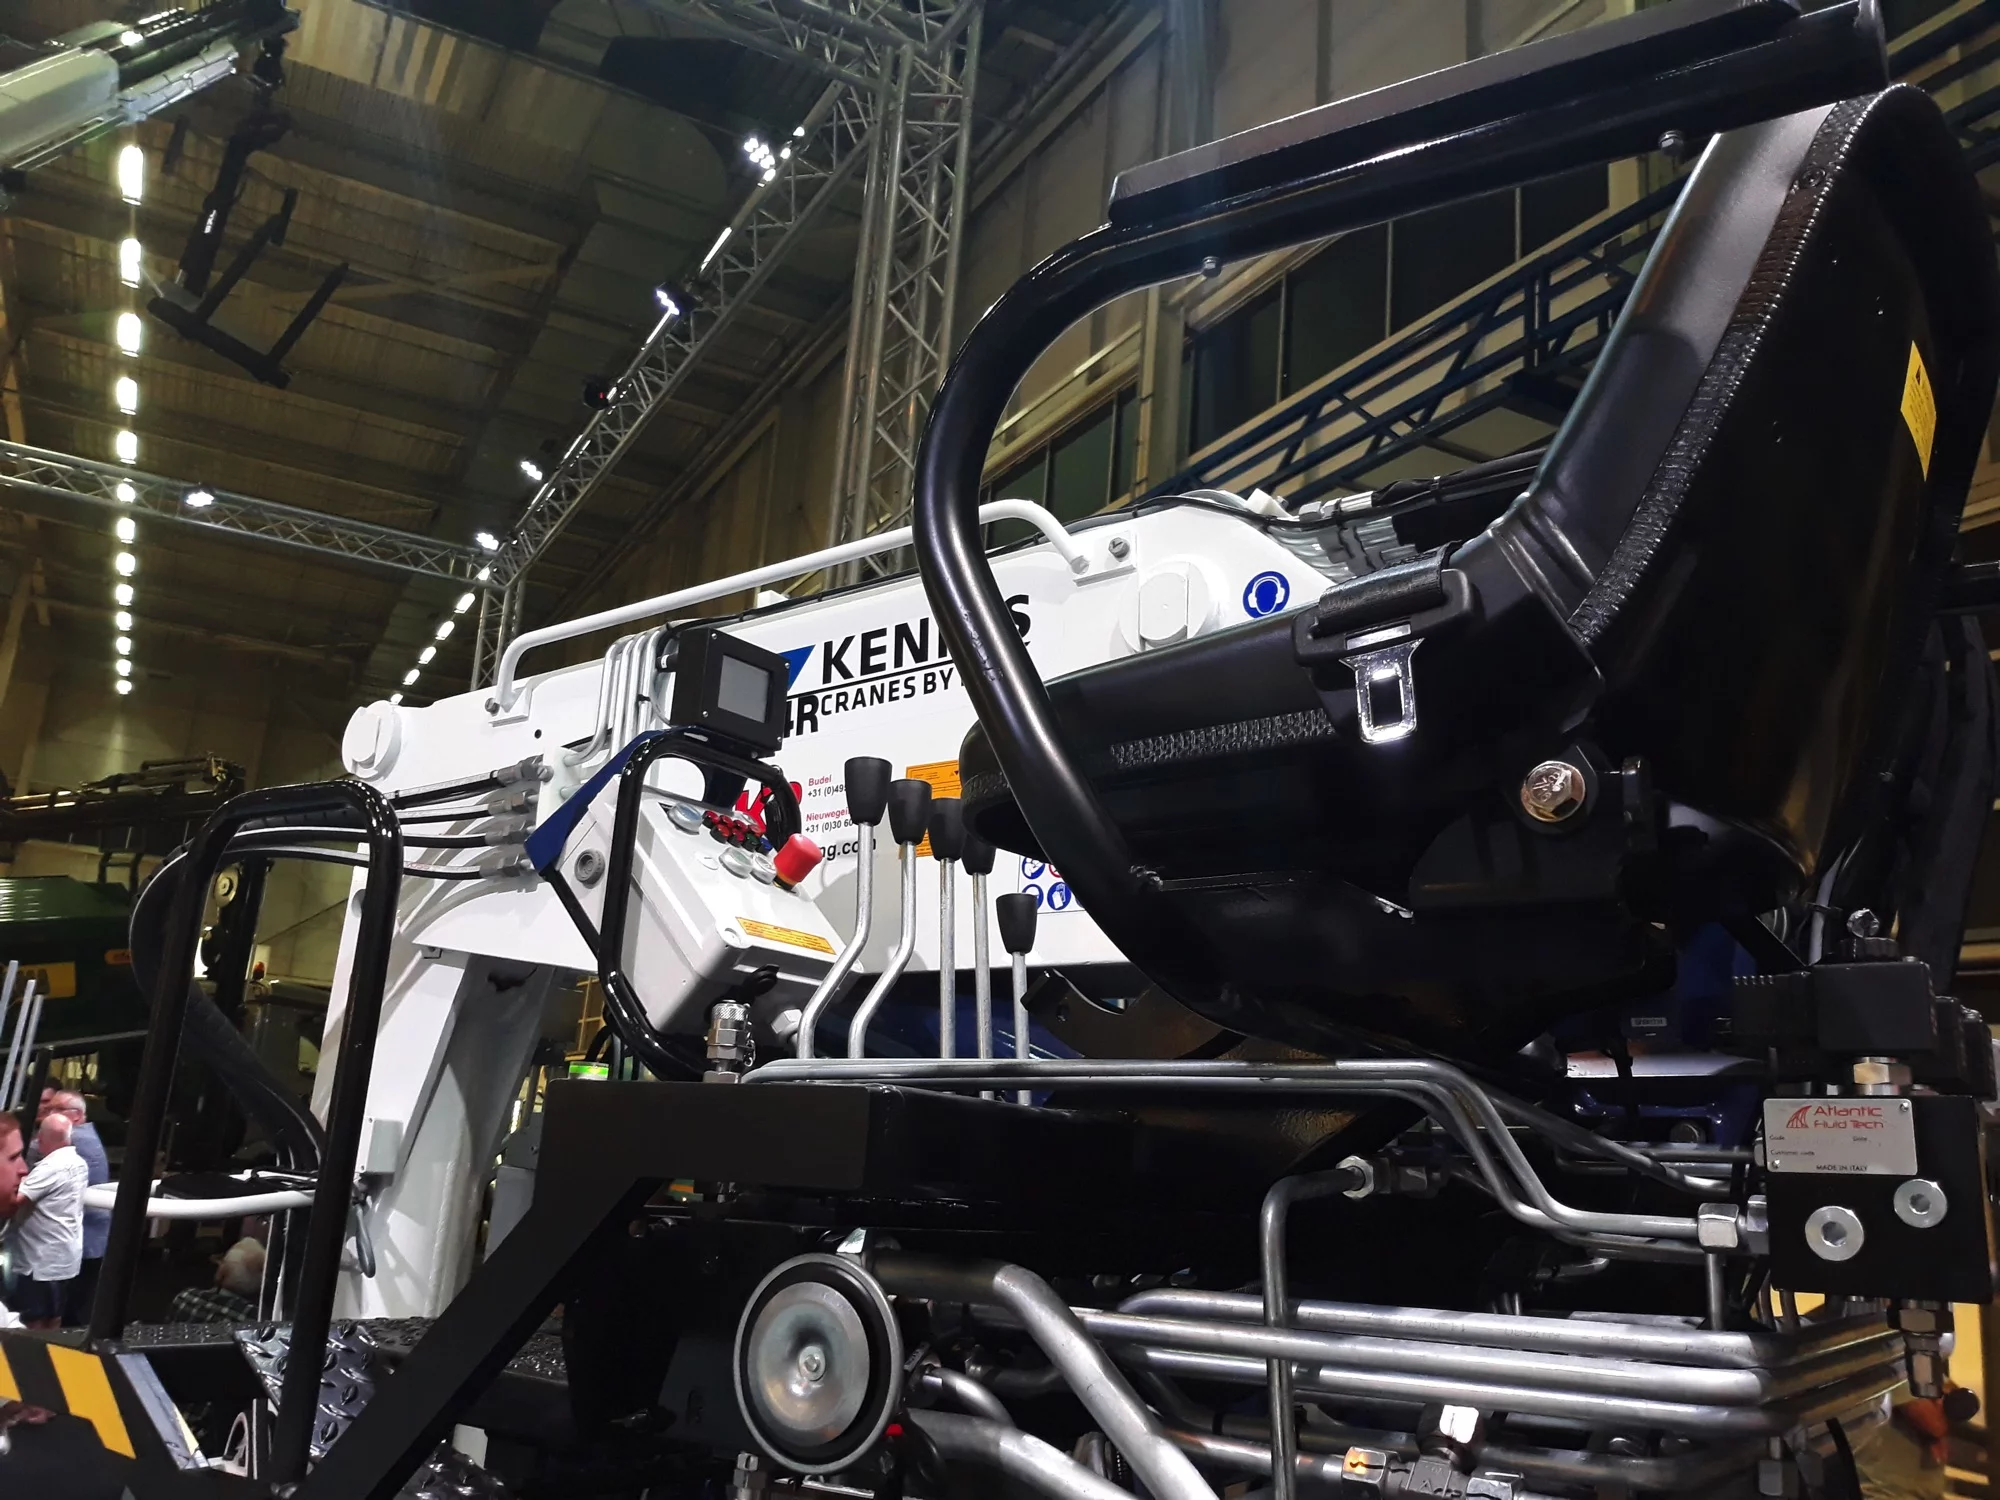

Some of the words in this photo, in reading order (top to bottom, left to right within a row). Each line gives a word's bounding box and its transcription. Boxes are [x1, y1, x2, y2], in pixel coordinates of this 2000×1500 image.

[821, 683, 916, 716] CRANES
[923, 668, 954, 695] BY
[808, 775, 832, 786] Budel
[807, 788, 821, 797] +31
[824, 784, 846, 796] (0)49
[805, 823, 819, 832] +31
[821, 820, 842, 832] (0)30
[1814, 1105, 1882, 1117] Atlantic
[1814, 1120, 1847, 1129] Fluid
[1850, 1120, 1884, 1129] Tech
